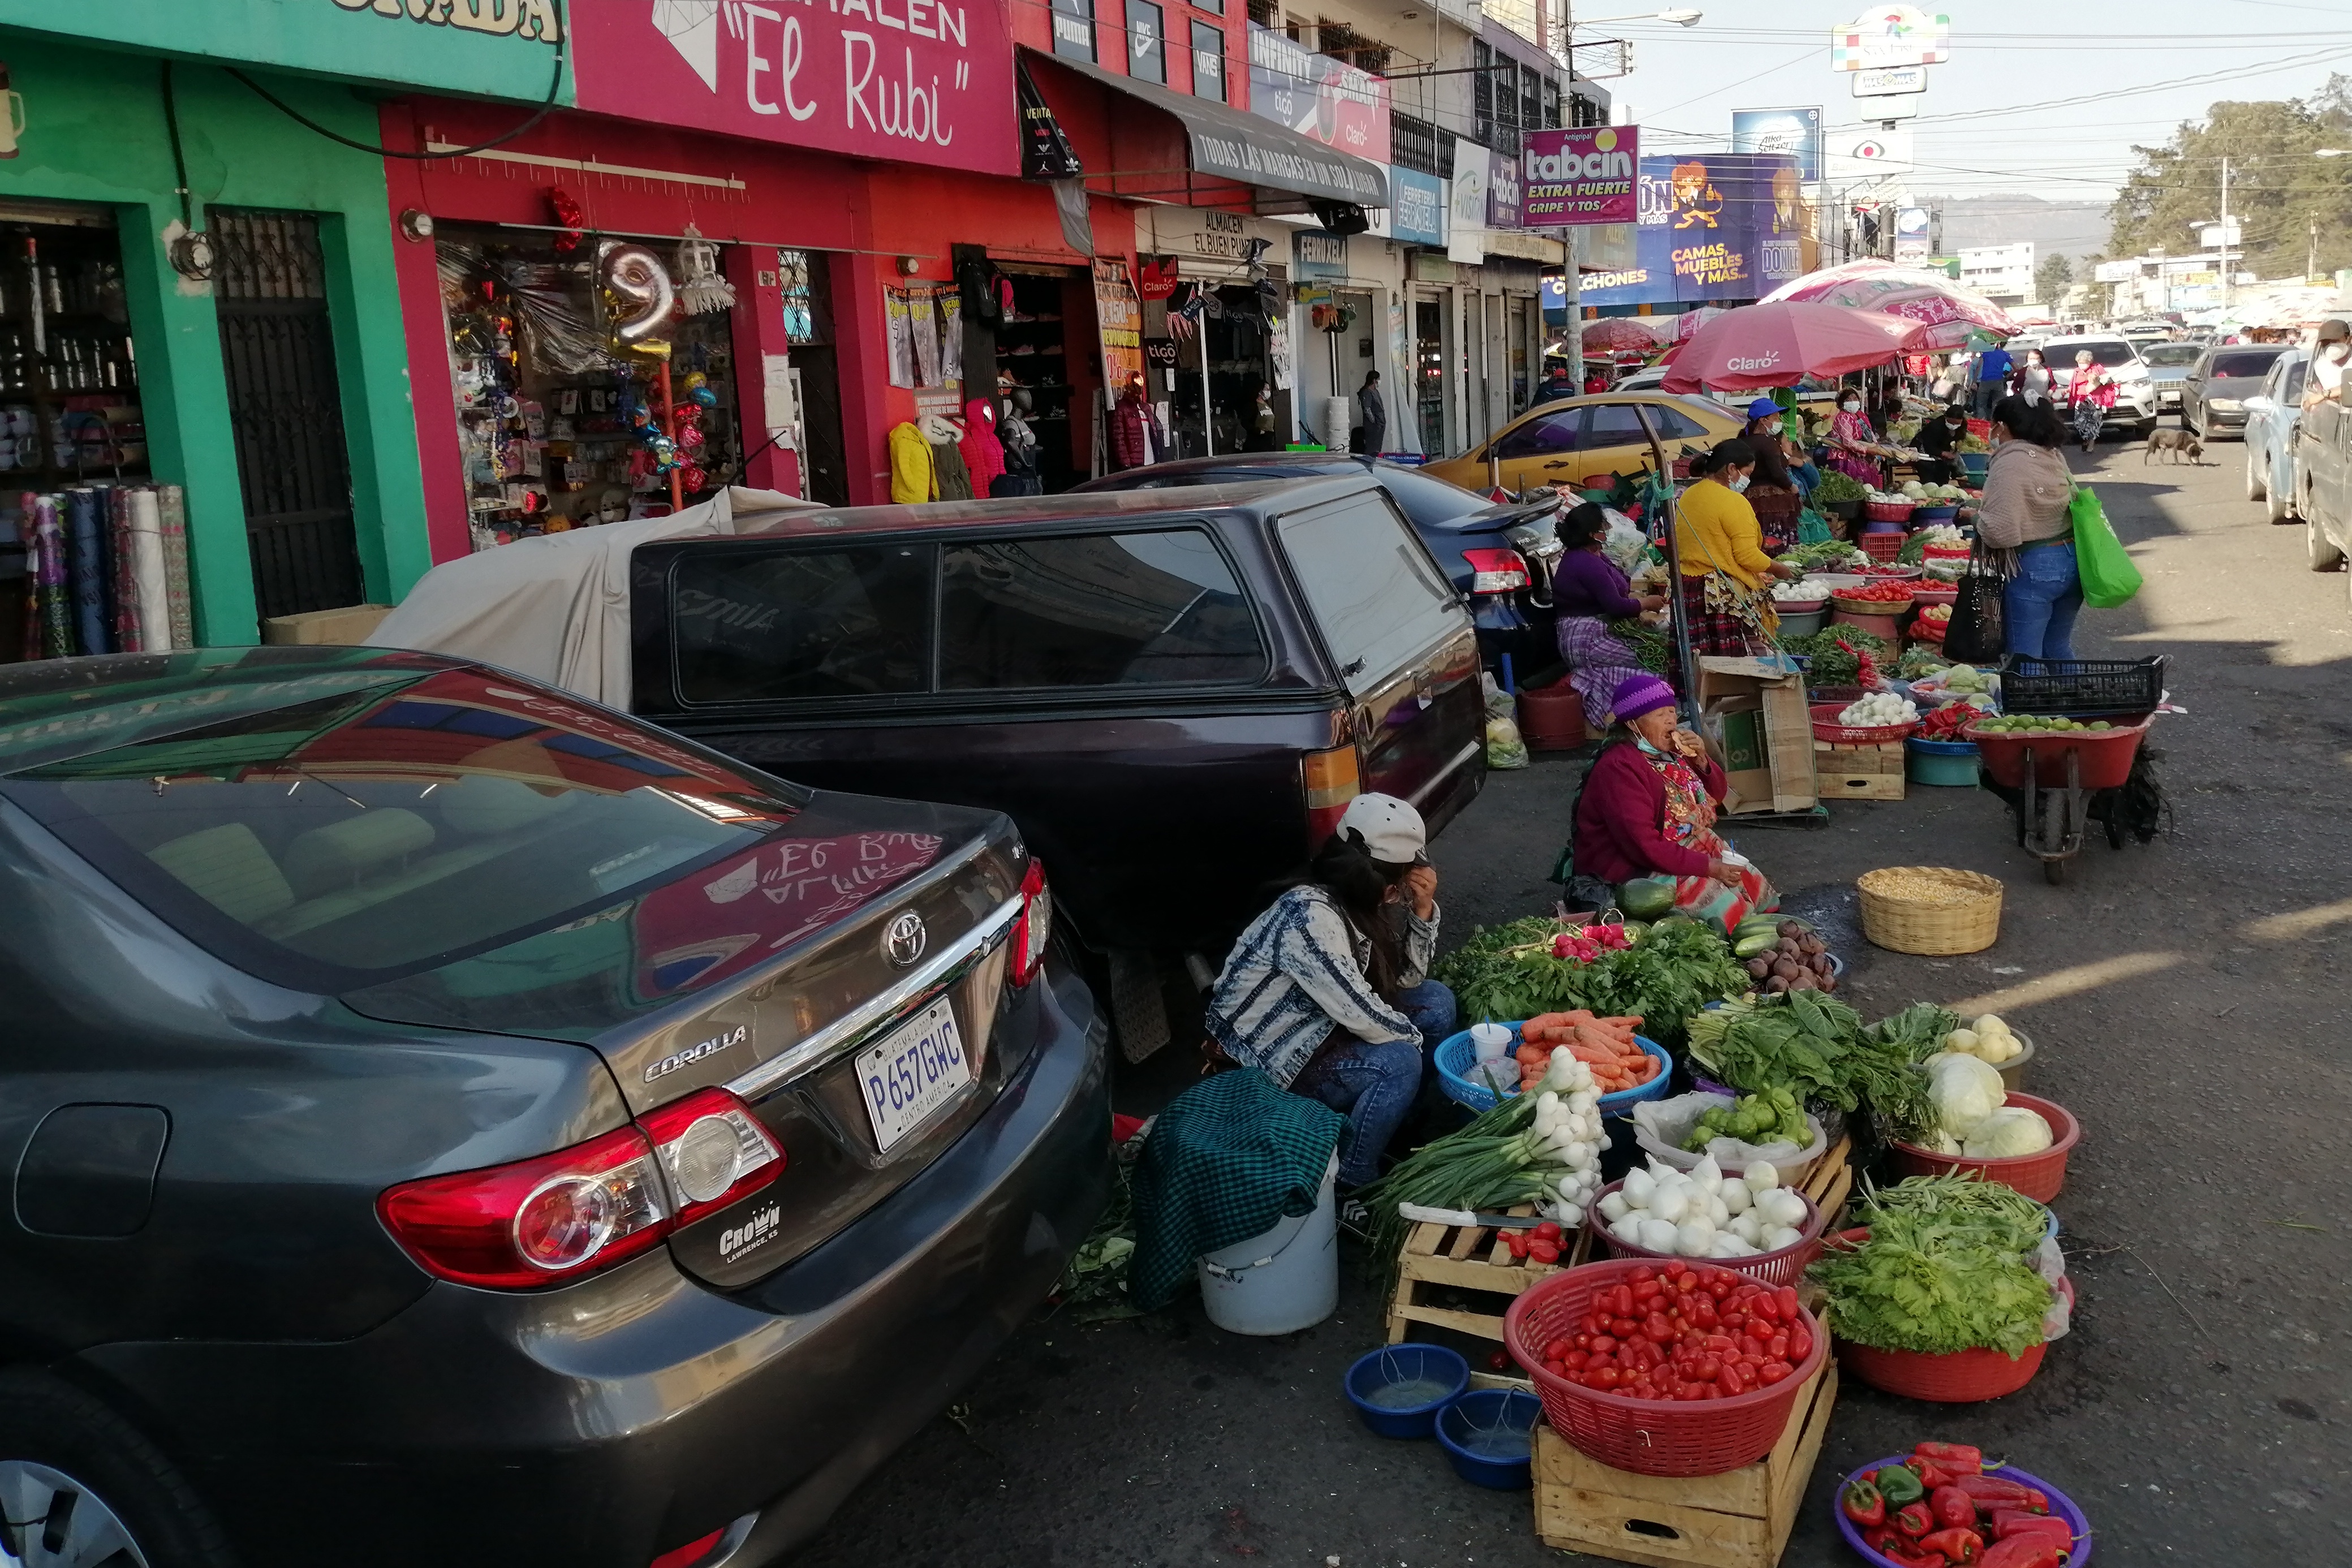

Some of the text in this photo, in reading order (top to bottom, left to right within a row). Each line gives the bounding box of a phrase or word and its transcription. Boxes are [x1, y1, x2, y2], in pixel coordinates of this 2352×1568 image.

[1056, 16, 1089, 47] PUMA
[1136, 20, 1152, 41] NIKE
[1196, 50, 1217, 77] VANS
[1253, 29, 1312, 91] INFINITY
[1341, 70, 1380, 120] SMART
[1027, 107, 1051, 119] VENTA
[1346, 122, 1379, 146] Claro
[1564, 131, 1592, 142] Antigripal
[1198, 134, 1379, 196] TODAS LAS MARCAS EN UN SOLO LUGAR
[1526, 144, 1634, 182] tabcin
[1403, 185, 1436, 206] FERRETERIA
[1528, 180, 1631, 198] EXTRA FUERTE
[1528, 201, 1601, 214] GRIPE Y TOS
[1647, 213, 1668, 224] MÁS
[1205, 212, 1244, 234] ALMACEN
[1195, 232, 1206, 252] EL
[1207, 234, 1230, 255] BUEN
[1672, 243, 1729, 262] CAMAS,
[1675, 254, 1743, 275] MUEBLES
[1762, 247, 1788, 272] DON
[1144, 279, 1173, 292] Claro
[1552, 269, 1648, 295] CCHONES
[1695, 273, 1705, 285] Y
[1727, 351, 1778, 371] Claro
[644, 1025, 747, 1083] COROLLA
[881, 1027, 923, 1062] GUATEMALA
[868, 1020, 960, 1124] P657GWC
[900, 1104, 925, 1127] CENTRO
[727, 1229, 778, 1264] LAWRENCE, KS
